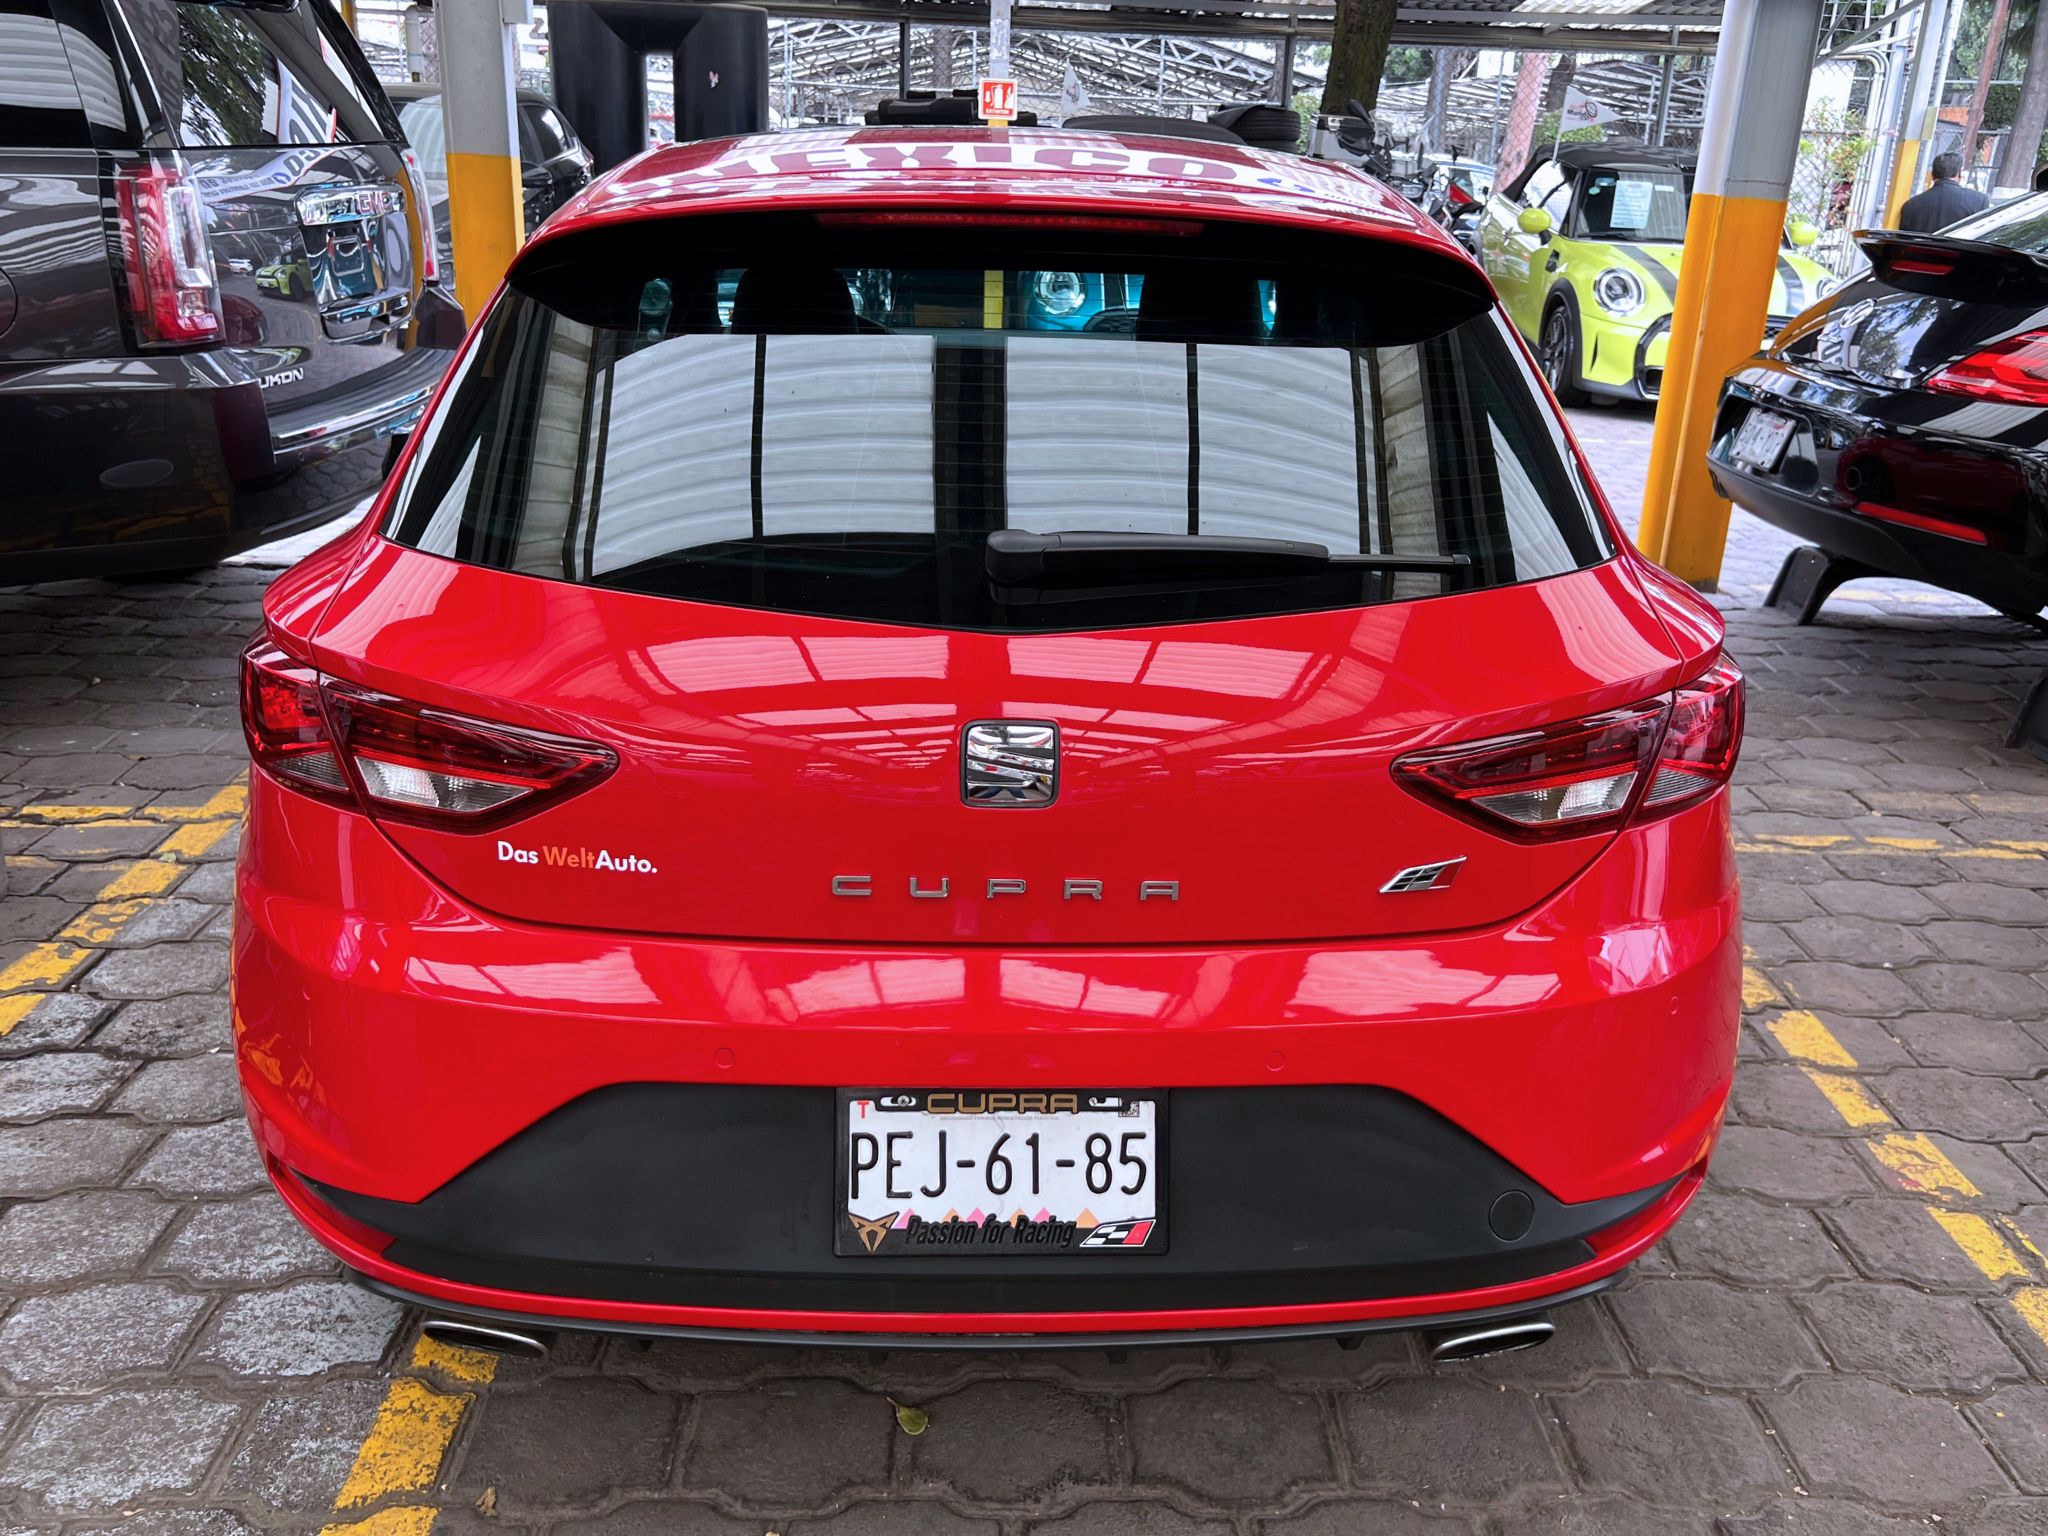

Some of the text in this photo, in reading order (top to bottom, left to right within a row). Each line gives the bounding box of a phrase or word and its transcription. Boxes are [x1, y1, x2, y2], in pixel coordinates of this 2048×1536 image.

[257, 367, 304, 390] UKON
[497, 840, 539, 865] Das
[831, 875, 1181, 902] CUPRA
[927, 1092, 1079, 1115] CUPRA
[850, 1130, 1148, 1200] PEJ-61-85
[904, 1212, 1079, 1249] Passion for Racing
